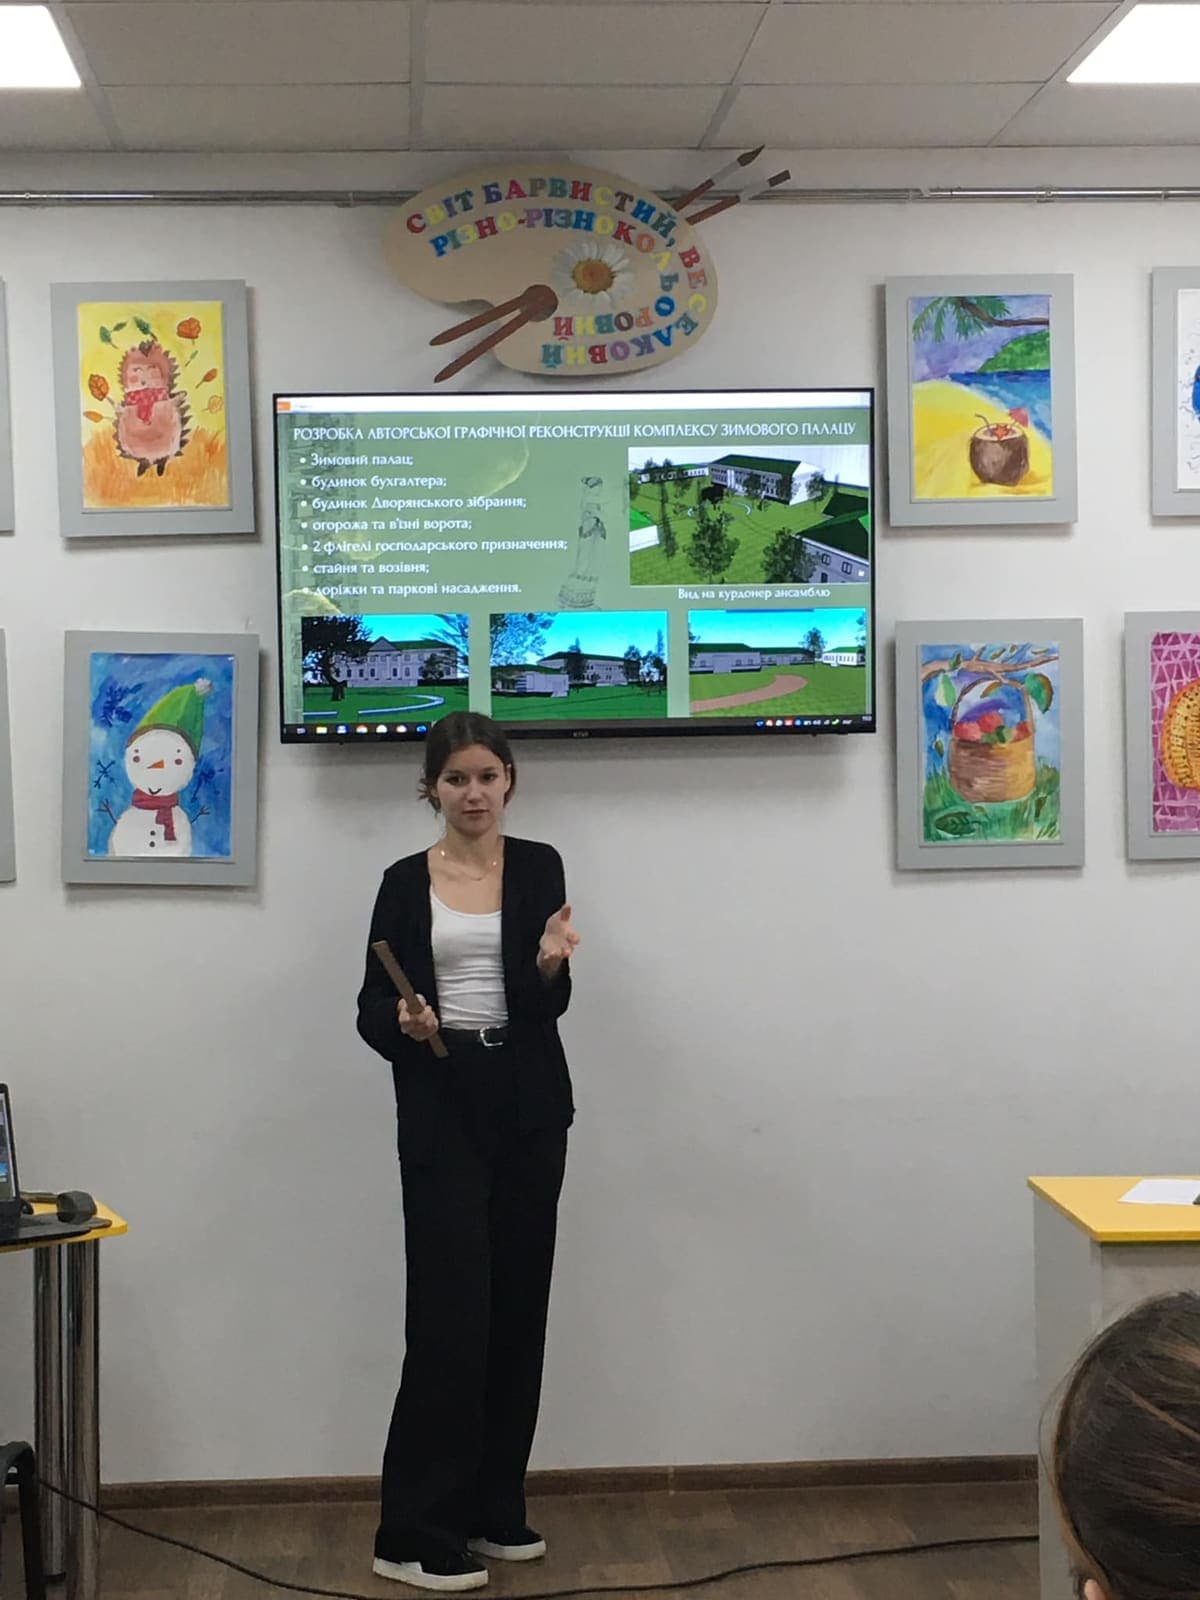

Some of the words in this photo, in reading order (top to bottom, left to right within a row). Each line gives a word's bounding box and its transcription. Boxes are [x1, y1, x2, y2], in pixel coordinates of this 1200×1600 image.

[406, 188, 474, 234] СВІТ
[482, 177, 677, 248] БАРВИСТИЙ,
[541, 246, 708, 369] ВЕСЕЛКОВИЙ
[293, 427, 363, 441] РОЗРОБКА
[368, 425, 451, 440] АВТОРСЬКОЇ
[455, 425, 526, 439] ГРАФІЧНОЇ
[529, 424, 630, 439] РЕКОНСТРУКЦІЇ
[634, 424, 718, 437] КОМПЛЕКСУ
[721, 423, 798, 436] ЗИМОВОГО
[802, 422, 856, 436] ПАЛАЦУ
[310, 453, 368, 467] Зимовий
[372, 455, 414, 467] палац;
[312, 476, 367, 489] будинок
[371, 476, 447, 489] бухгалтера;
[312, 498, 368, 511] будинок
[372, 497, 463, 510] Дворянського
[466, 496, 527, 509] зібрання;
[313, 520, 368, 533] огорожа
[371, 521, 385, 530] та
[424, 519, 472, 531] ворота;
[313, 541, 321, 552] 2
[324, 540, 371, 555] флігелі
[375, 541, 477, 553] господарського
[481, 540, 568, 552] призначення;
[313, 562, 357, 574] стайня
[361, 564, 375, 573] та
[379, 562, 429, 574] возівня;
[314, 584, 367, 597] доріжки
[371, 585, 384, 594] та
[388, 583, 437, 596] паркові
[441, 582, 522, 595] насадження.
[678, 588, 699, 600] Вид
[702, 590, 715, 599] на
[775, 588, 831, 599] ансамблю
